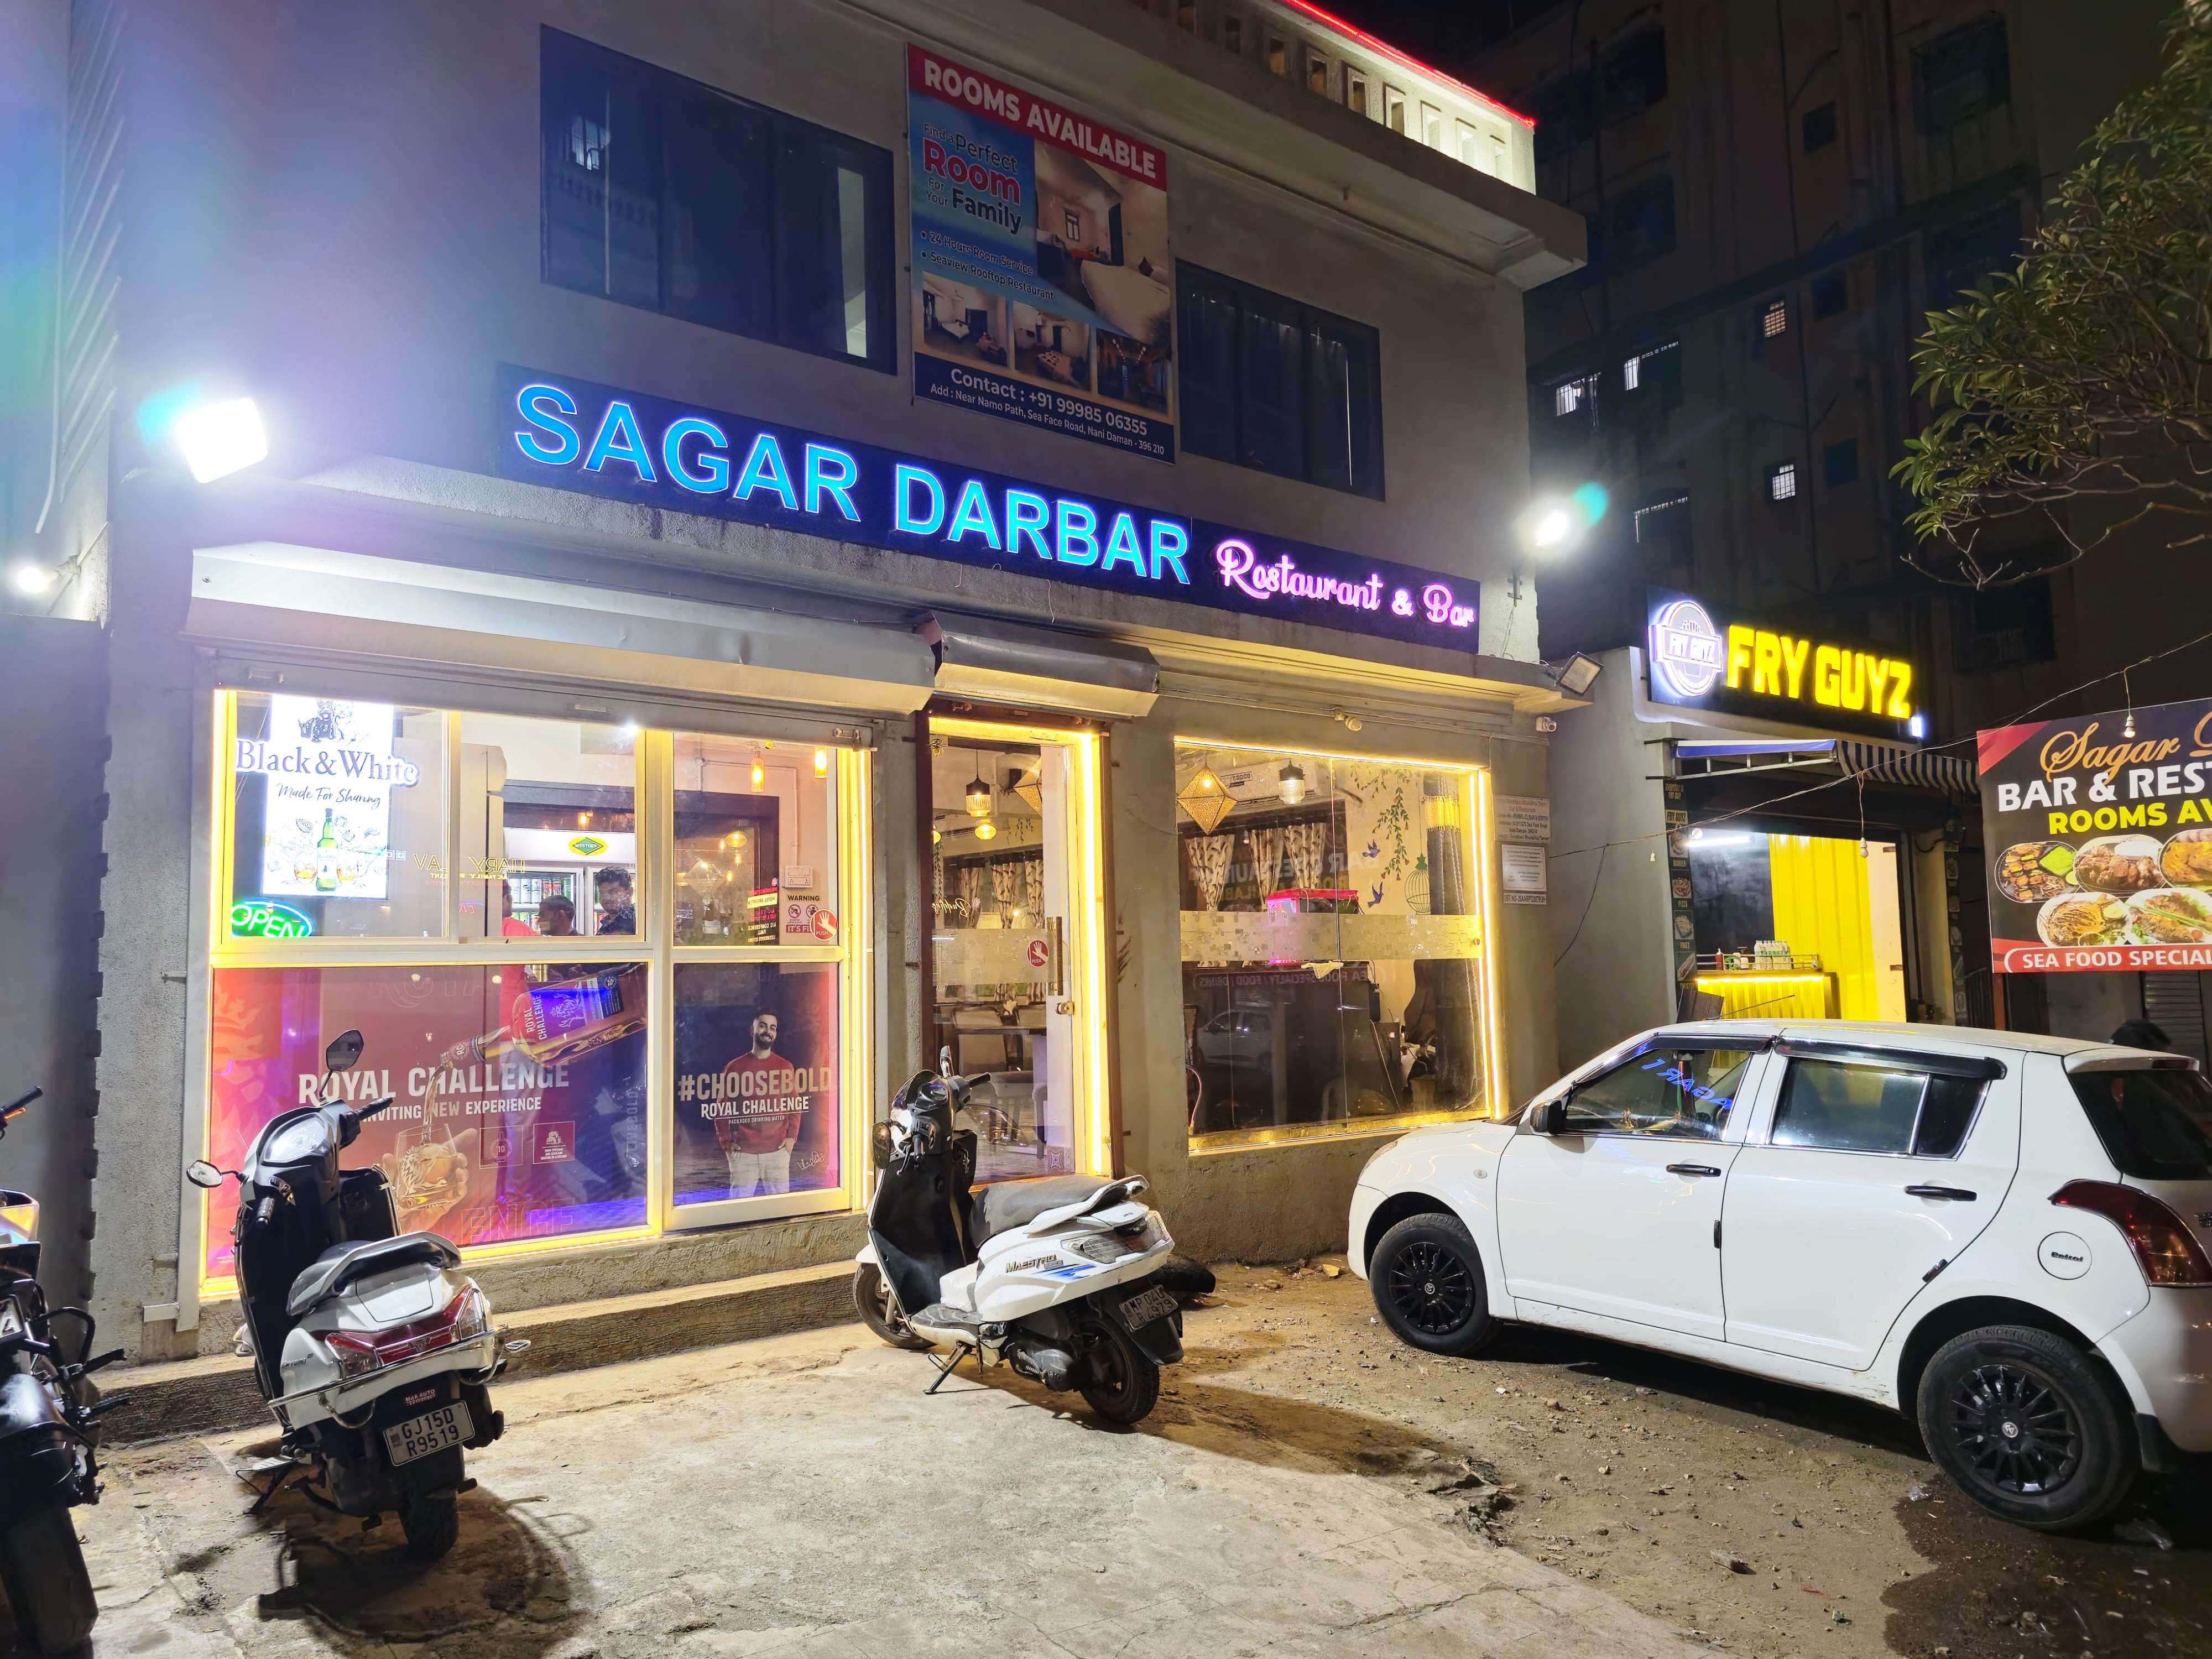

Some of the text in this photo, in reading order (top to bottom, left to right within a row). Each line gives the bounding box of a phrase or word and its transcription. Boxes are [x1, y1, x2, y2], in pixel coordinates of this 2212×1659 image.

[924, 58, 1155, 179] ROOMS AVAILABLE
[924, 123, 945, 140] Find
[956, 133, 1018, 174] Perfect
[929, 177, 945, 191] For
[925, 187, 1022, 234] Your Family
[930, 232, 1032, 275] 24 Hours Room Service
[930, 252, 1054, 301] Seaview Rooftop Restaurant
[931, 383, 948, 396] Add
[956, 389, 975, 404] Near
[978, 395, 1003, 412] Namo
[1005, 401, 1026, 419] Path,
[1027, 409, 1042, 422] Sea
[1044, 413, 1062, 427] Face
[1064, 418, 1086, 435] Road,
[1087, 425, 1105, 440] Nani
[1107, 430, 1133, 447] Daman
[1139, 440, 1152, 452] 396
[1153, 444, 1165, 455] 210
[951, 368, 1016, 399] Contact
[1029, 391, 1052, 410] +91
[1057, 397, 1102, 424] 99985
[1106, 411, 1147, 436] 06355
[514, 383, 1191, 585] SAGAR DARBAR
[1216, 540, 1475, 628] Restaurant & Bar
[1726, 624, 1911, 719] FRY GUYZ
[236, 740, 418, 783] Black & White
[2039, 722, 2180, 786] Sagar
[276, 782, 381, 808] Made For Sharing
[1997, 776, 2078, 812] BAR
[2088, 772, 2117, 802] &
[2048, 802, 2168, 835] ROOMS
[231, 904, 305, 937] OPEN
[2022, 953, 2059, 968] SEA
[2065, 951, 2122, 967] FOOD
[524, 1006, 535, 1034] ROYAL
[533, 994, 548, 1041] CHALLENGE
[299, 1070, 396, 1108] ROYAL
[408, 1062, 570, 1097] CHALLENGE
[678, 1067, 831, 1102] #CHOOSEBOLD
[363, 1097, 542, 1122] NVITING NEW EXPERIENCE
[701, 1096, 809, 1120] ROYAL CHALLENGE
[2051, 1252, 2084, 1262] Petrol
[1129, 1297, 1142, 1313] MP
[405, 1394, 419, 1402] MAA
[419, 1389, 436, 1398] AUTO
[401, 1408, 454, 1439] GJ15D
[406, 1425, 460, 1457] R9519
